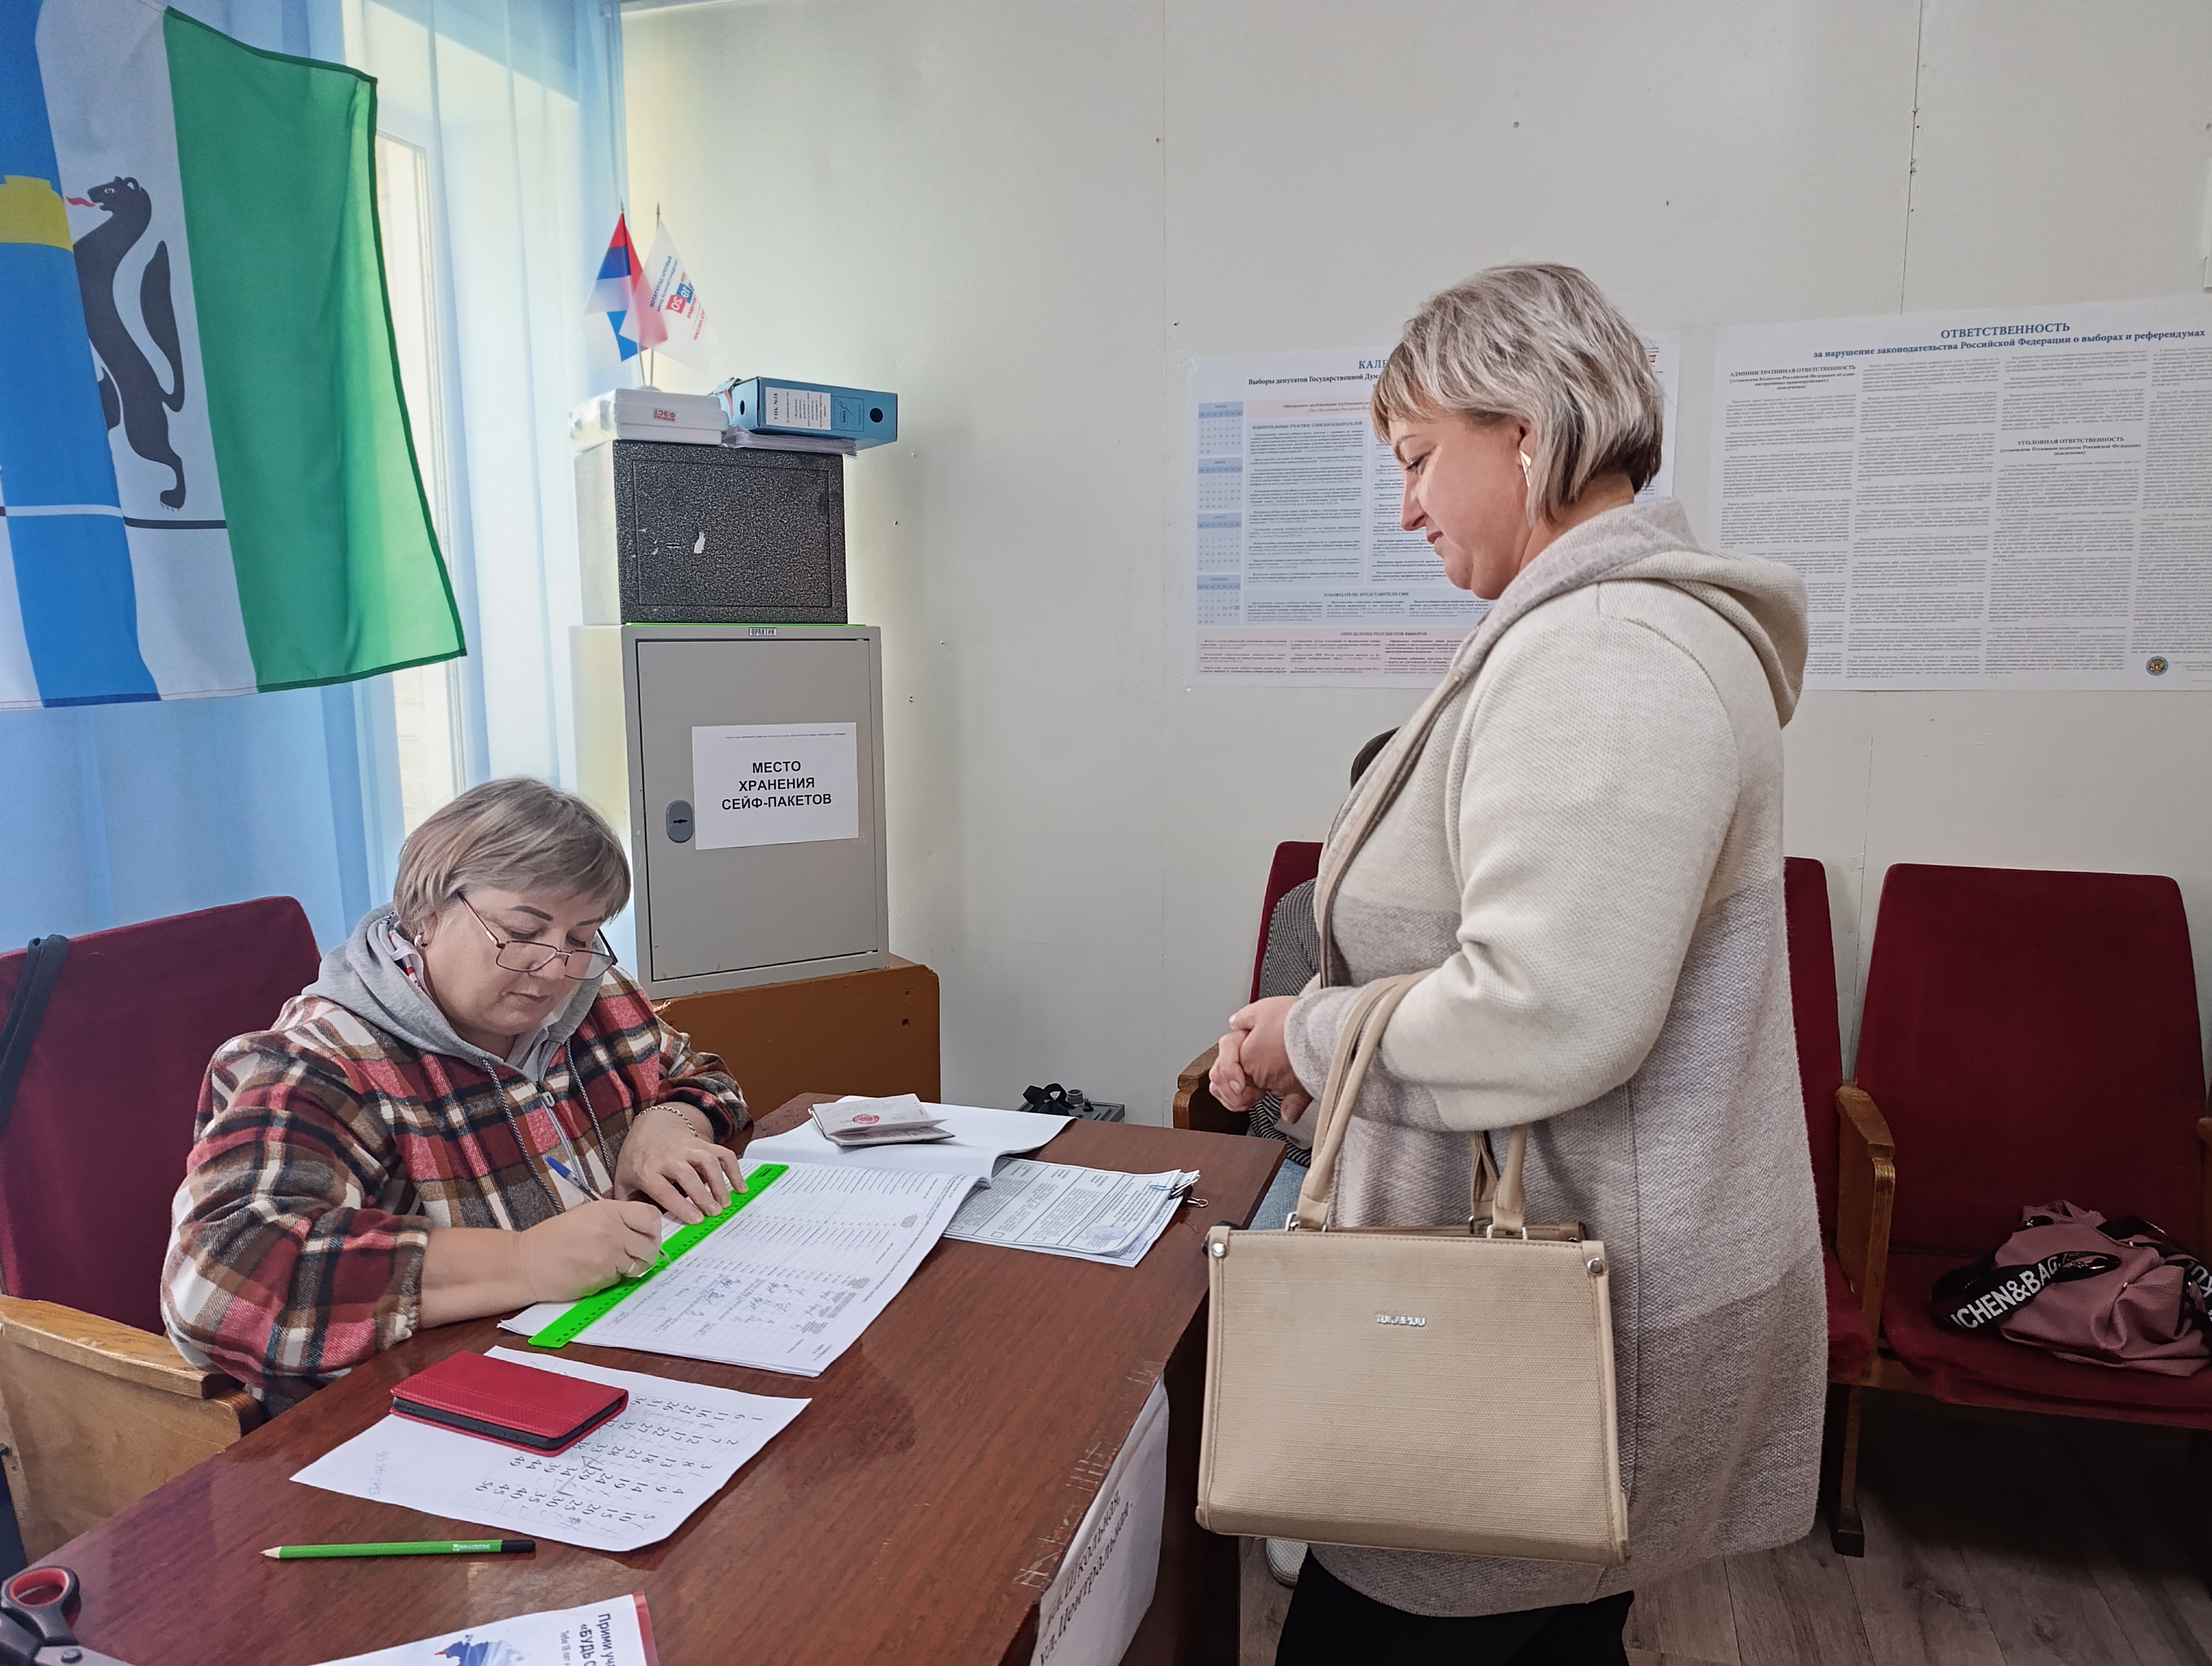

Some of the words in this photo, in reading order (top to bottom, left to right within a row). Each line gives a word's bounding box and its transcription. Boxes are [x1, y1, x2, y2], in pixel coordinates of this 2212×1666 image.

[1940, 323, 2070, 339] ОТВЕТСТВЕННОСТЬ
[1825, 349, 1875, 359] нарушение
[1876, 344, 1958, 354] законодательства
[1960, 338, 2015, 349] Российской
[2017, 337, 2071, 347] Федерации
[2081, 334, 2124, 343] выборах
[2133, 330, 2205, 342] референдумах
[1729, 368, 1796, 377] АДМИНИСТРАТИВНАЯ
[1796, 364, 1856, 373] ОТВЕТСТВЕННОСТЬ
[1249, 378, 1275, 386] Выборы
[1309, 374, 1364, 383] Государственной
[654, 409, 676, 418] ФЭСТ
[752, 760, 801, 773] МЕСТО
[738, 777, 815, 792] ХРАНЕНИЯ
[722, 793, 832, 810] СЕЙФ-ПАКЕТОВ
[646, 1398, 663, 1407] 31
[661, 1401, 681, 1412] 26
[678, 1404, 697, 1416] 21
[695, 1408, 711, 1417] 16
[617, 1420, 636, 1429] 32
[638, 1423, 654, 1434] 27
[651, 1425, 670, 1436] 22
[671, 1432, 688, 1442] 17
[685, 1434, 703, 1444] 12
[589, 1442, 609, 1454] 33
[605, 1445, 627, 1458] 28
[623, 1447, 644, 1461] 23
[510, 1457, 527, 1468] 49
[640, 1452, 659, 1463] 18
[658, 1457, 676, 1467] 13
[526, 1460, 542, 1469] 44
[544, 1465, 562, 1474] 39
[559, 1465, 577, 1476] 34
[579, 1468, 598, 1481] 29
[594, 1471, 615, 1486] 24
[475, 1482, 494, 1493] 50
[491, 1482, 512, 1496] 45
[612, 1477, 632, 1490] 19
[629, 1481, 648, 1492] 14
[509, 1488, 529, 1500] 40
[529, 1494, 547, 1504] 35
[544, 1494, 567, 1509] 30
[563, 1499, 584, 1512] 25
[581, 1502, 603, 1516] 20
[600, 1507, 618, 1518] 15
[617, 1511, 636, 1521] 10
[560, 1630, 570, 1644] Тебе
[596, 1613, 613, 1650] Прими
[579, 1624, 595, 1659] «БУДЬ
[563, 1652, 571, 1661] лет
